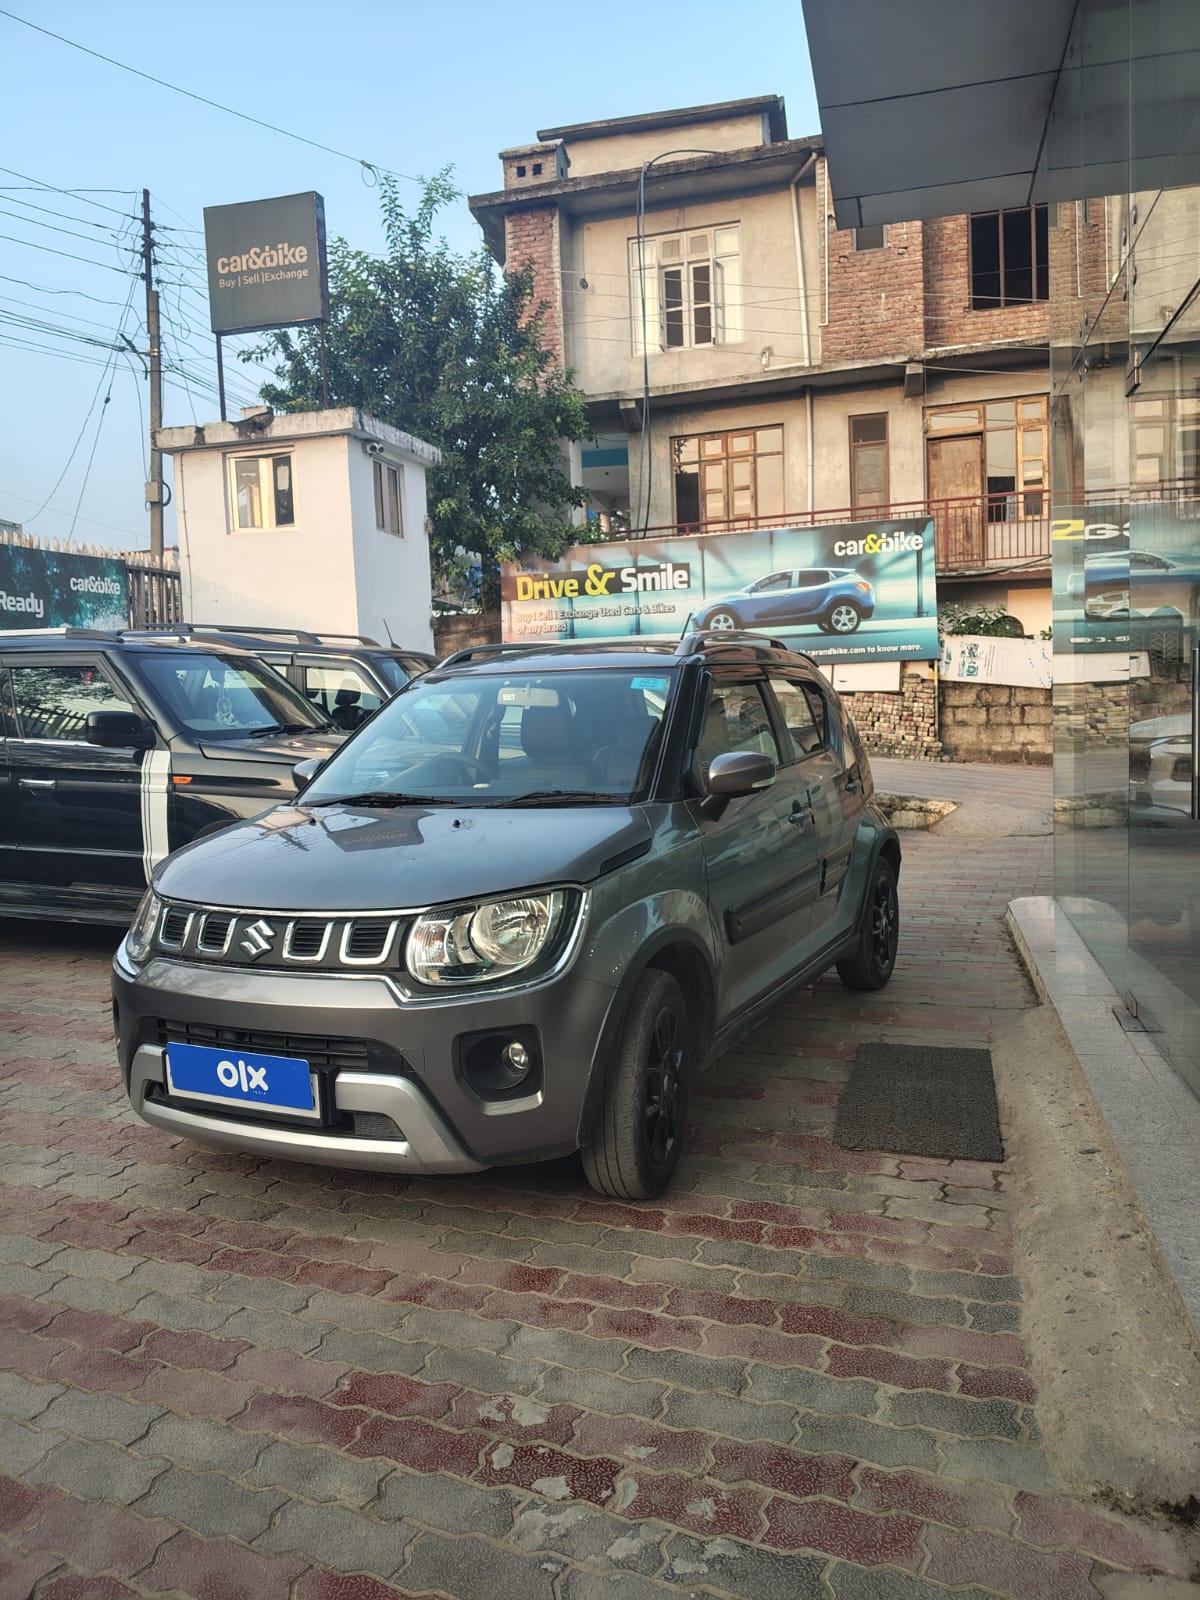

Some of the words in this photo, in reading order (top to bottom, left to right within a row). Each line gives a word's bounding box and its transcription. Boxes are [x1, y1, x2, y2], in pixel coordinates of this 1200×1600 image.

[217, 242, 308, 274] car&bike
[218, 278, 236, 288] Buy
[243, 274, 260, 285] Sell
[834, 531, 923, 557] car&bike
[70, 575, 121, 595] car&bike
[516, 573, 579, 600] Drive
[585, 563, 615, 596] &
[621, 562, 689, 592] Smile
[559, 608, 599, 620] Exchange
[601, 605, 622, 617] Used
[624, 605, 642, 616] Cars
[651, 603, 676, 614] Bikes
[867, 645, 876, 654] to
[877, 644, 899, 653] know
